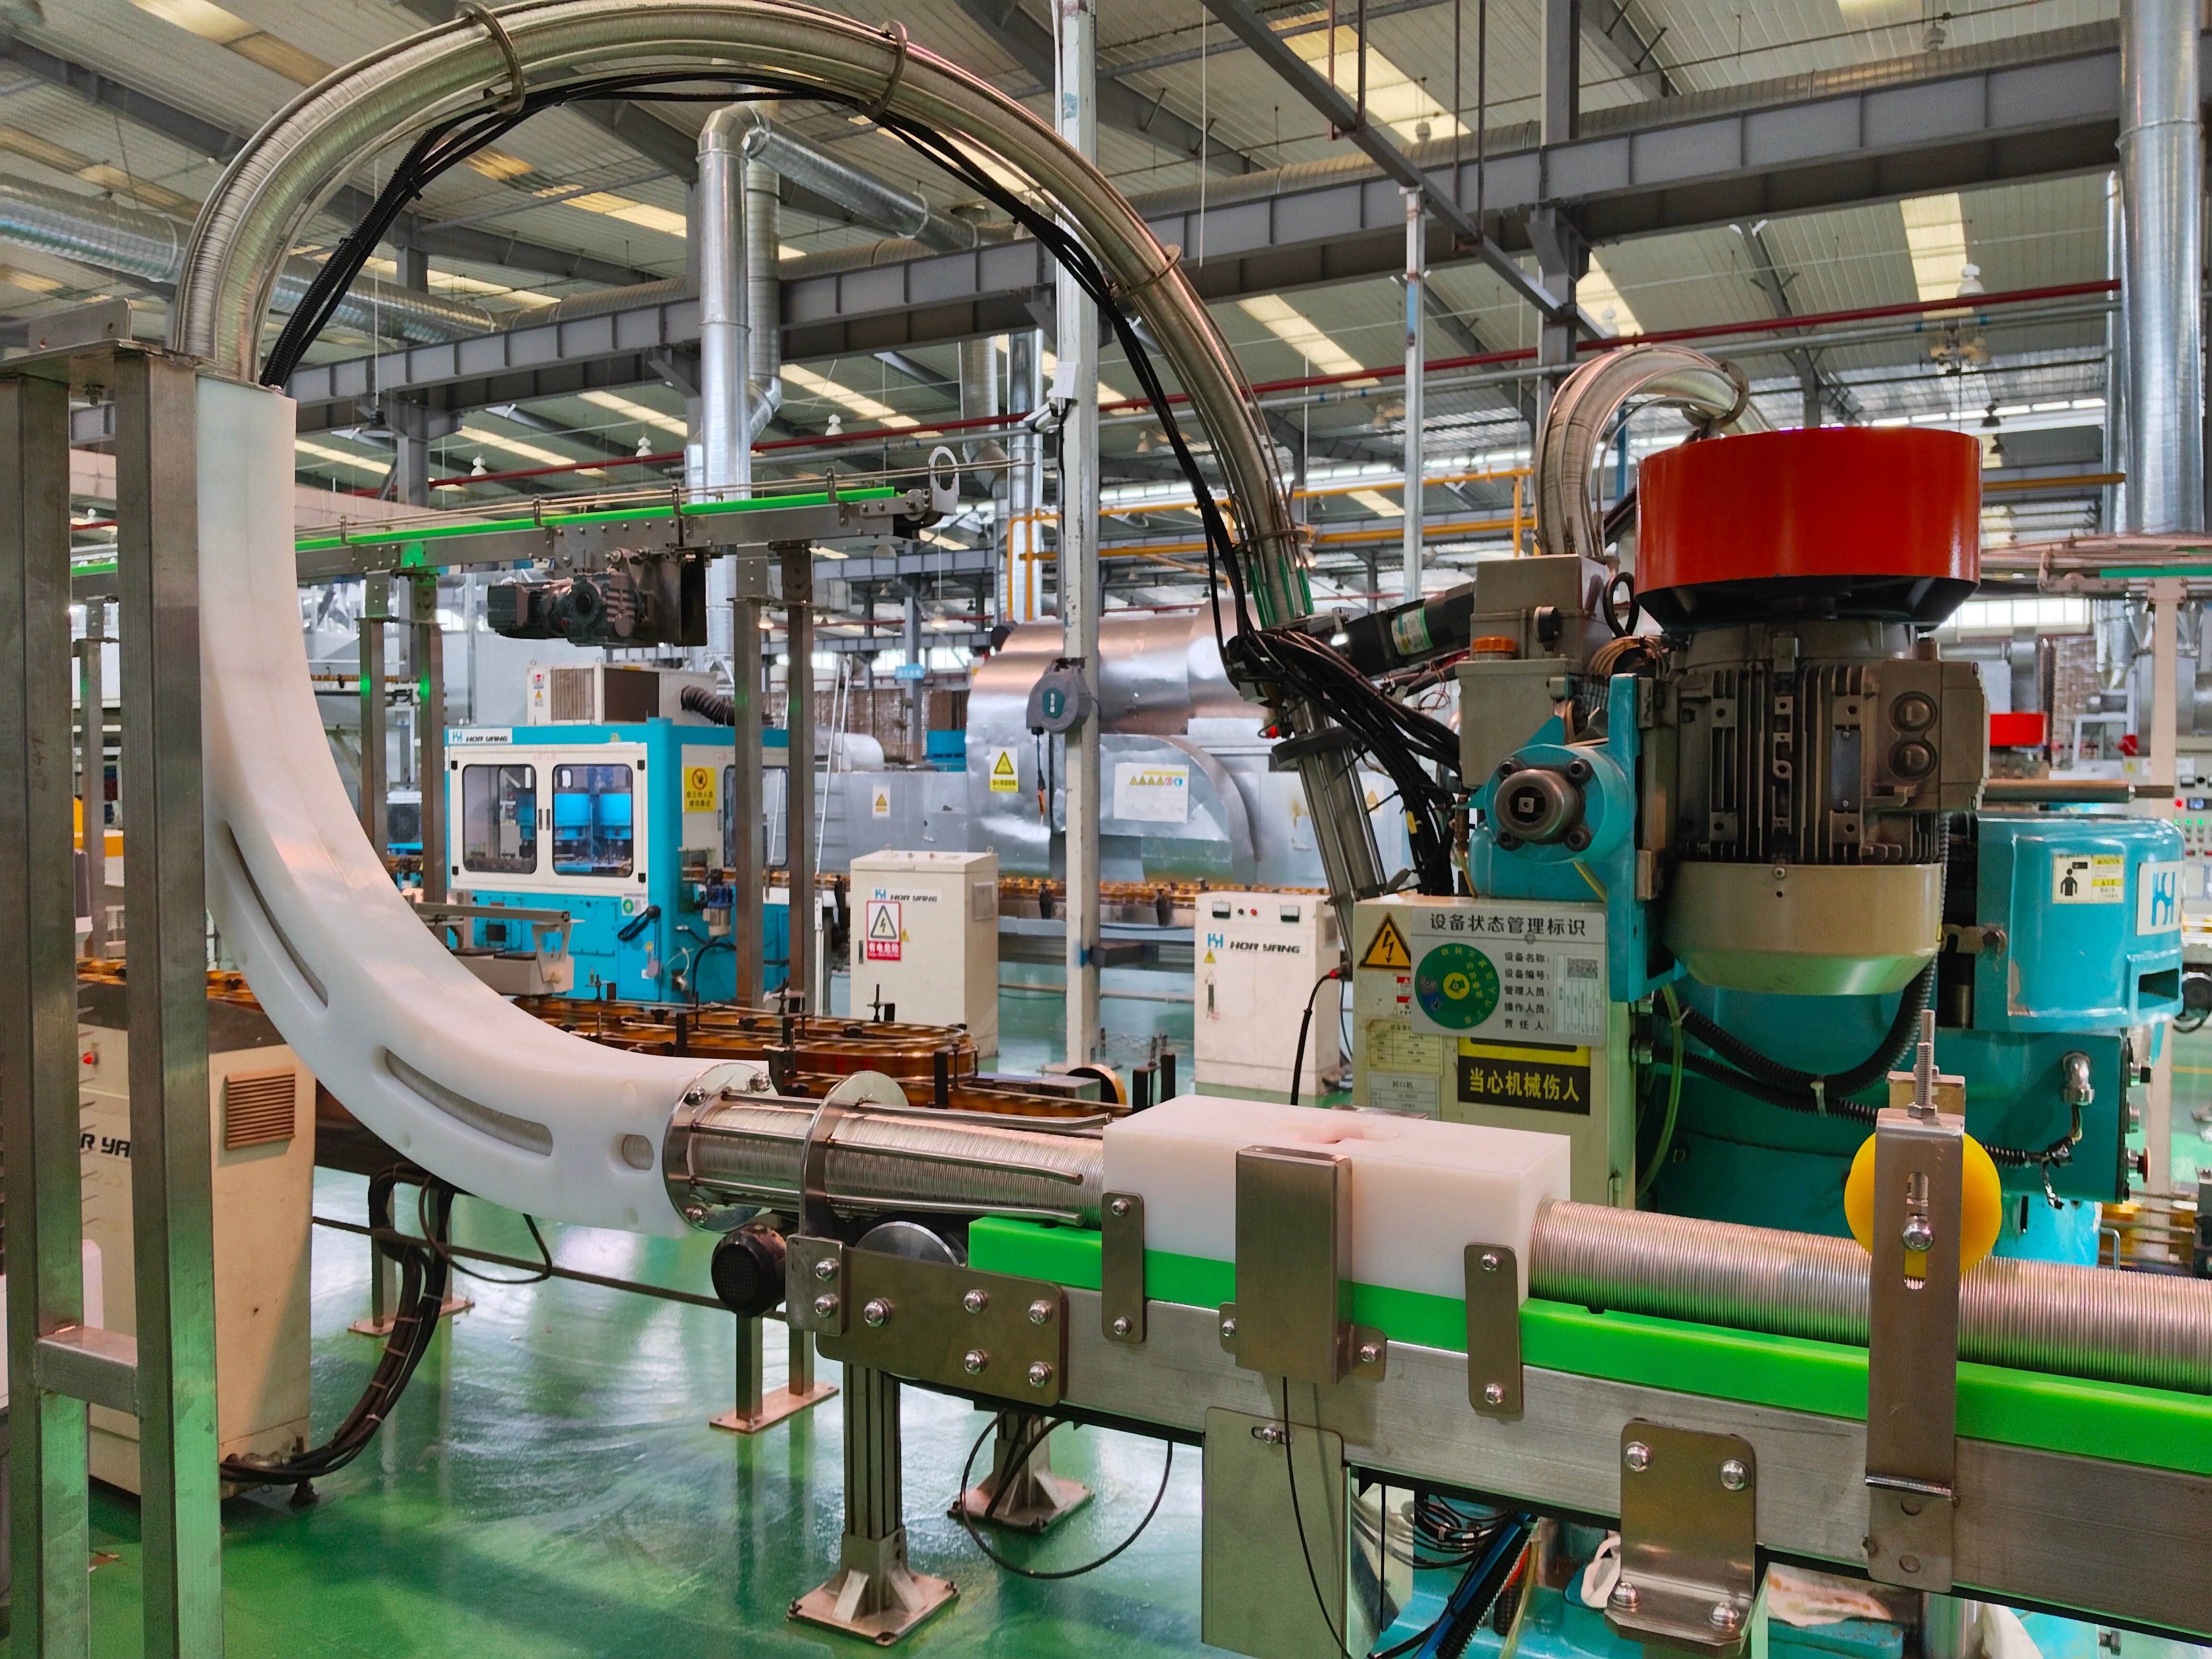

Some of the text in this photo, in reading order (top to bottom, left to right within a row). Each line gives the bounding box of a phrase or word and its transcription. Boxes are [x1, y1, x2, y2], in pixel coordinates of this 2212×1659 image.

[1431, 913, 1586, 936] 设备状态管理标识
[1230, 941, 1259, 950] HOR
[1262, 943, 1300, 954] YANG
[1469, 1067, 1580, 1102] 当心机械伤人
